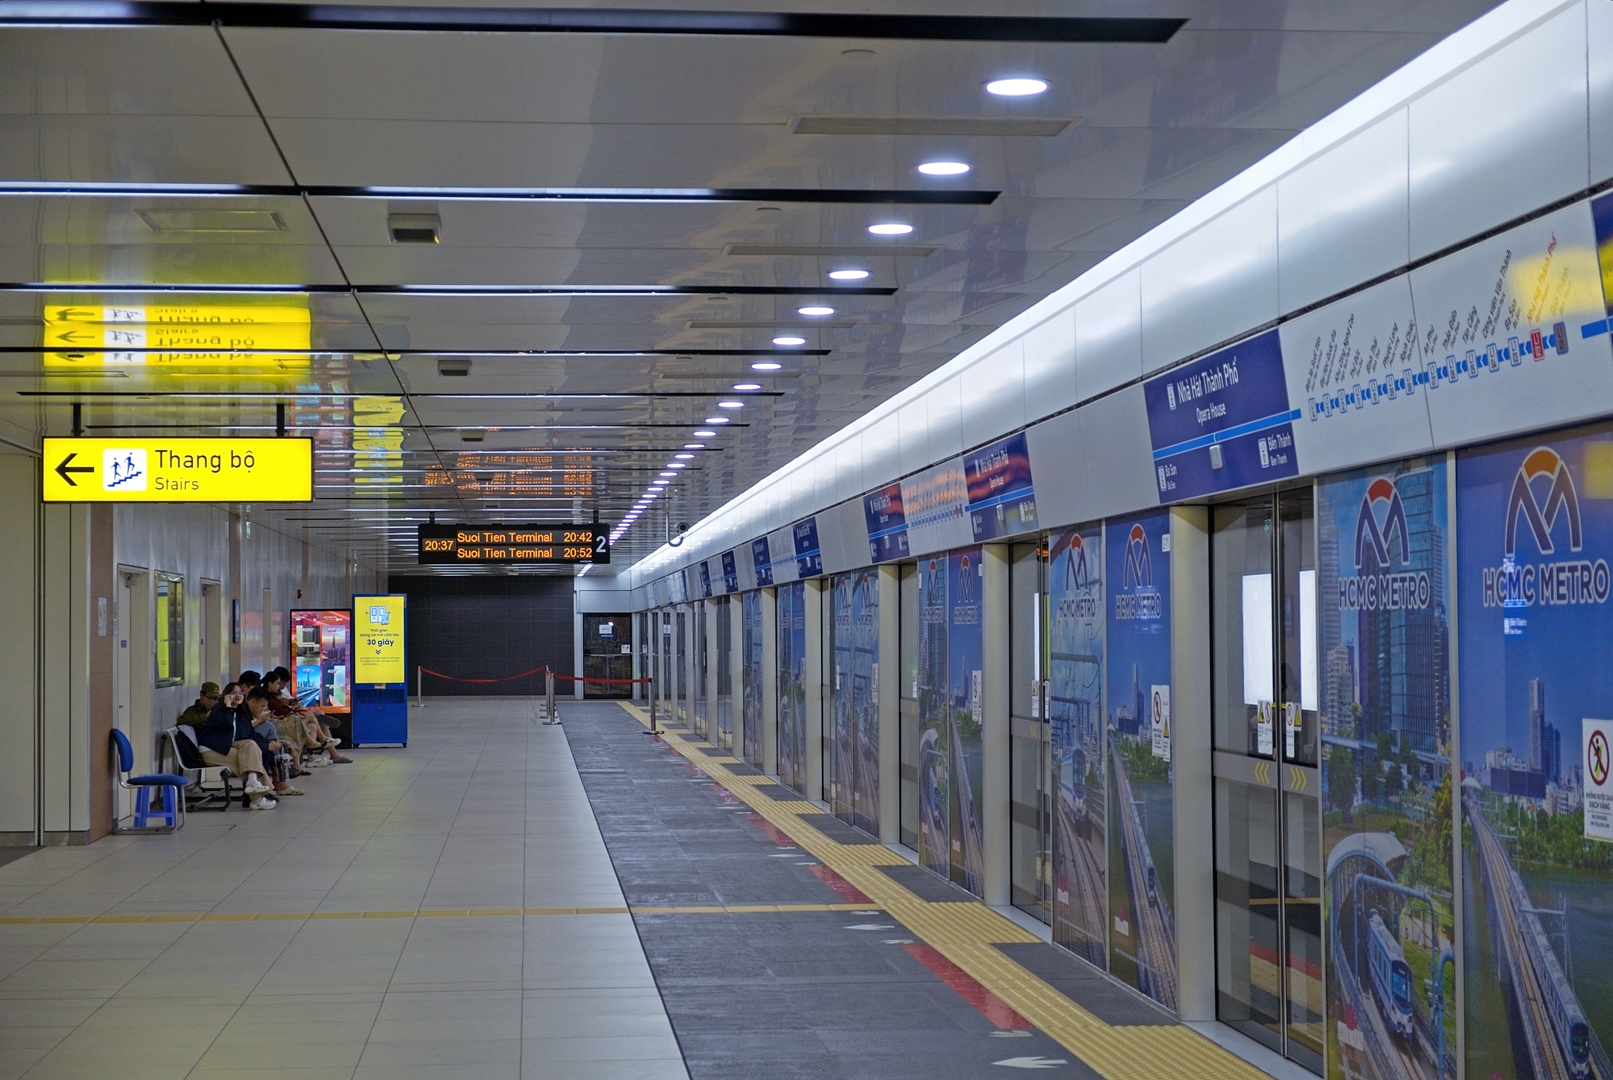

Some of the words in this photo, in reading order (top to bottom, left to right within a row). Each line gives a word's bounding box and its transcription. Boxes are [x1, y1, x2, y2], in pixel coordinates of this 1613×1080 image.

[1177, 379, 1191, 403] Nhà
[1190, 374, 1203, 399] Hát
[1201, 366, 1225, 394] Thành
[1223, 356, 1239, 387] Phố
[1196, 407, 1211, 426] Opera
[1209, 402, 1226, 418] House
[1267, 434, 1278, 450] Bến
[1276, 432, 1292, 448] Thành
[155, 449, 221, 473] Thang
[231, 449, 255, 473] bộ
[155, 477, 199, 491] Stairs
[425, 540, 454, 550] 20:37
[457, 532, 480, 543] Suoi
[484, 532, 506, 543] Tien
[509, 532, 553, 543] Terminal
[563, 532, 593, 543] 20:42
[596, 535, 606, 553] 2
[457, 548, 480, 559] Suoi
[484, 548, 506, 559] Tien
[509, 548, 553, 559] Terminal
[563, 548, 593, 559] 20:52
[1338, 574, 1377, 610] HCMC
[1379, 572, 1431, 609] METRO
[1483, 564, 1536, 607] HCMC
[1539, 558, 1611, 605] METRO
[1059, 598, 1075, 618] HCMC
[1074, 597, 1096, 618] METRO
[1115, 594, 1135, 619] HCMC
[1135, 592, 1162, 619] METRO
[377, 638, 395, 647] giây
[1589, 801, 1599, 810] VẠCH
[1600, 801, 1610, 811] VÀNG
